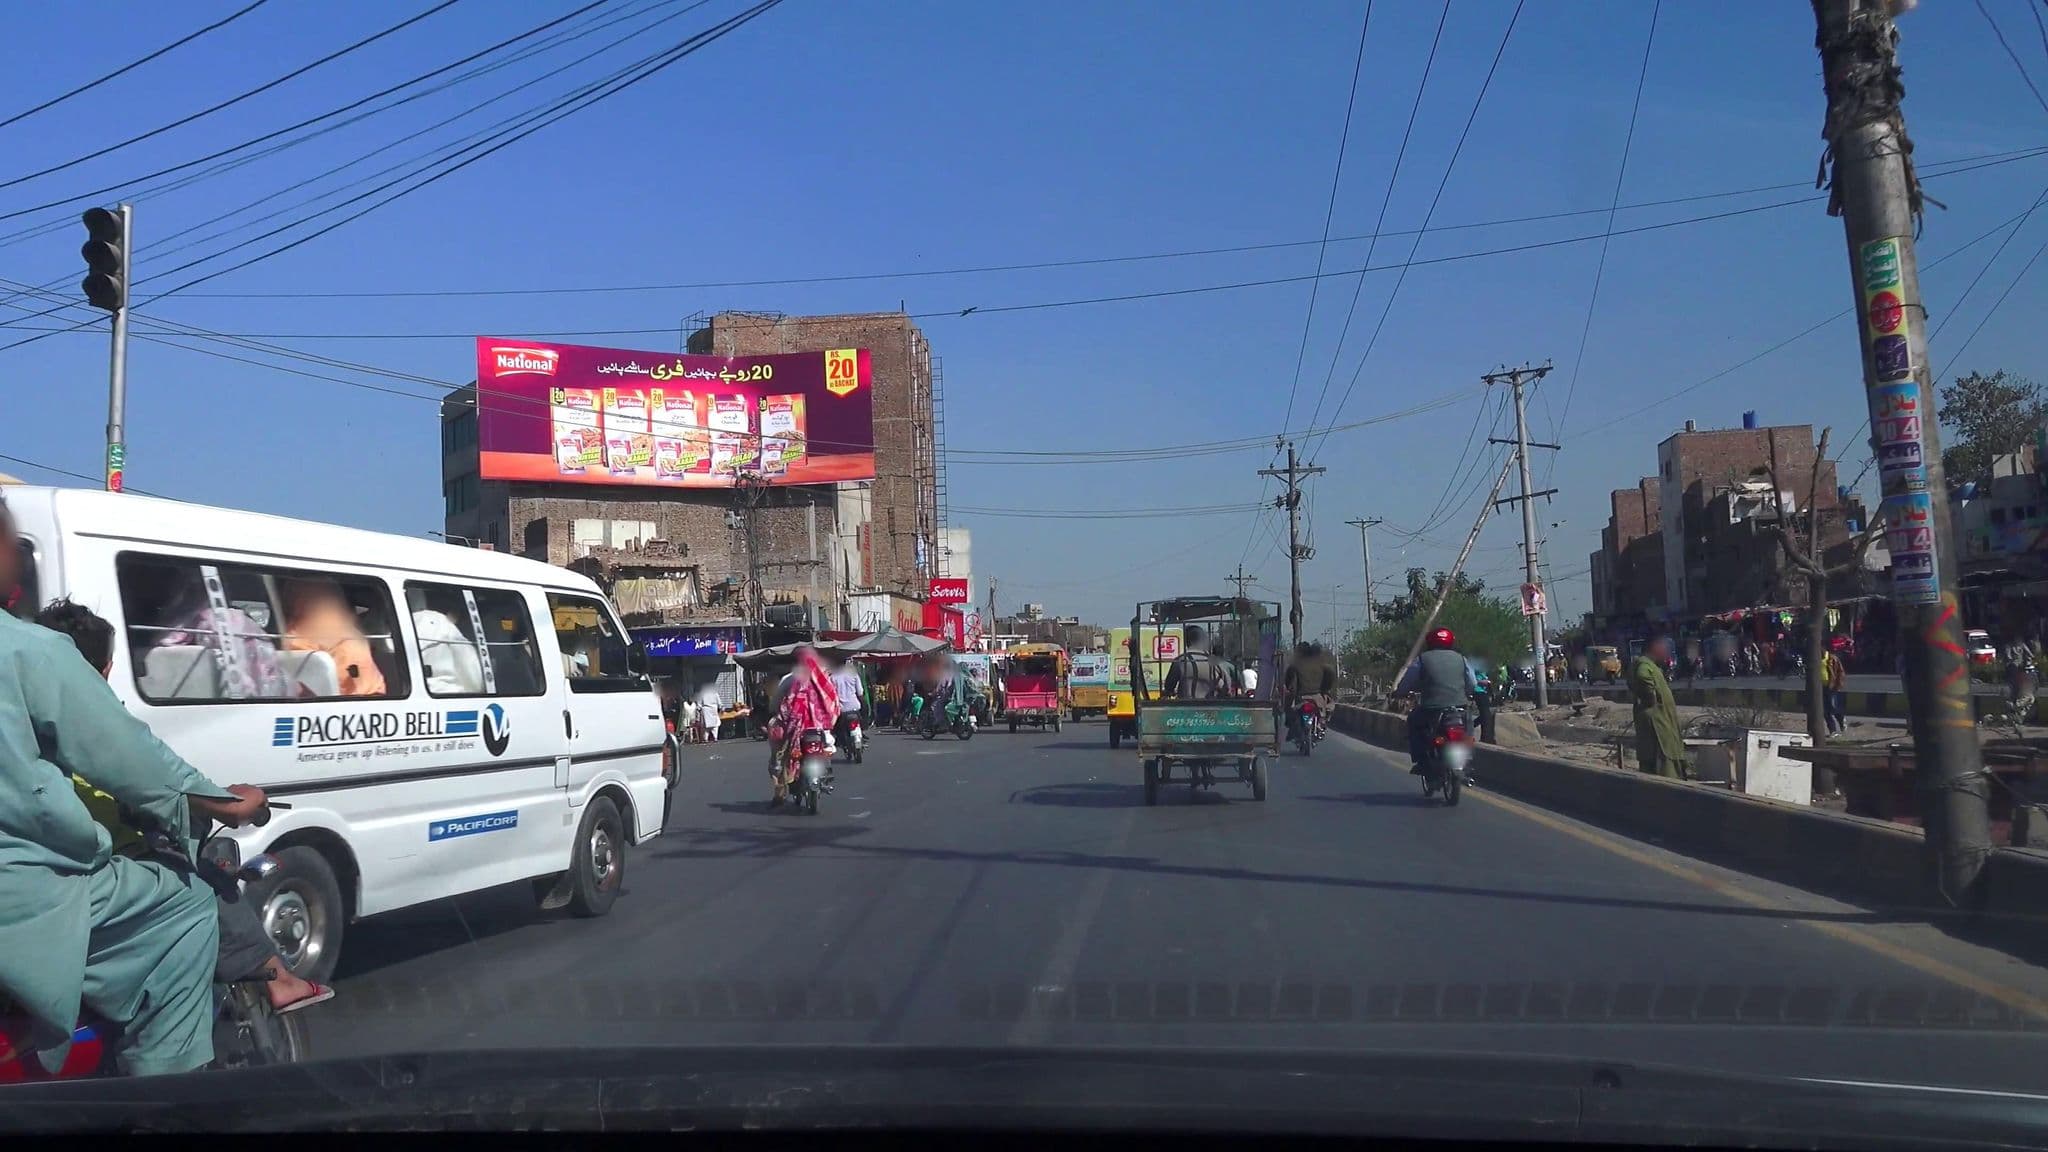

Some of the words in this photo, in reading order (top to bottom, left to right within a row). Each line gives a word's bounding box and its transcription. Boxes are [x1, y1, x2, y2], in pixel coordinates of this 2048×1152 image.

[497, 352, 552, 370] National
[650, 359, 684, 380] فری
[829, 358, 854, 379] 20
[751, 364, 773, 380] 20
[653, 393, 662, 401] 20
[298, 713, 399, 743] PACKARD
[405, 712, 443, 736] BELL
[297, 751, 335, 762] America
[337, 750, 358, 763] grew
[361, 748, 373, 760] up
[375, 744, 409, 757] listening
[411, 744, 420, 753] to
[443, 741, 456, 751] still
[457, 740, 475, 749] does
